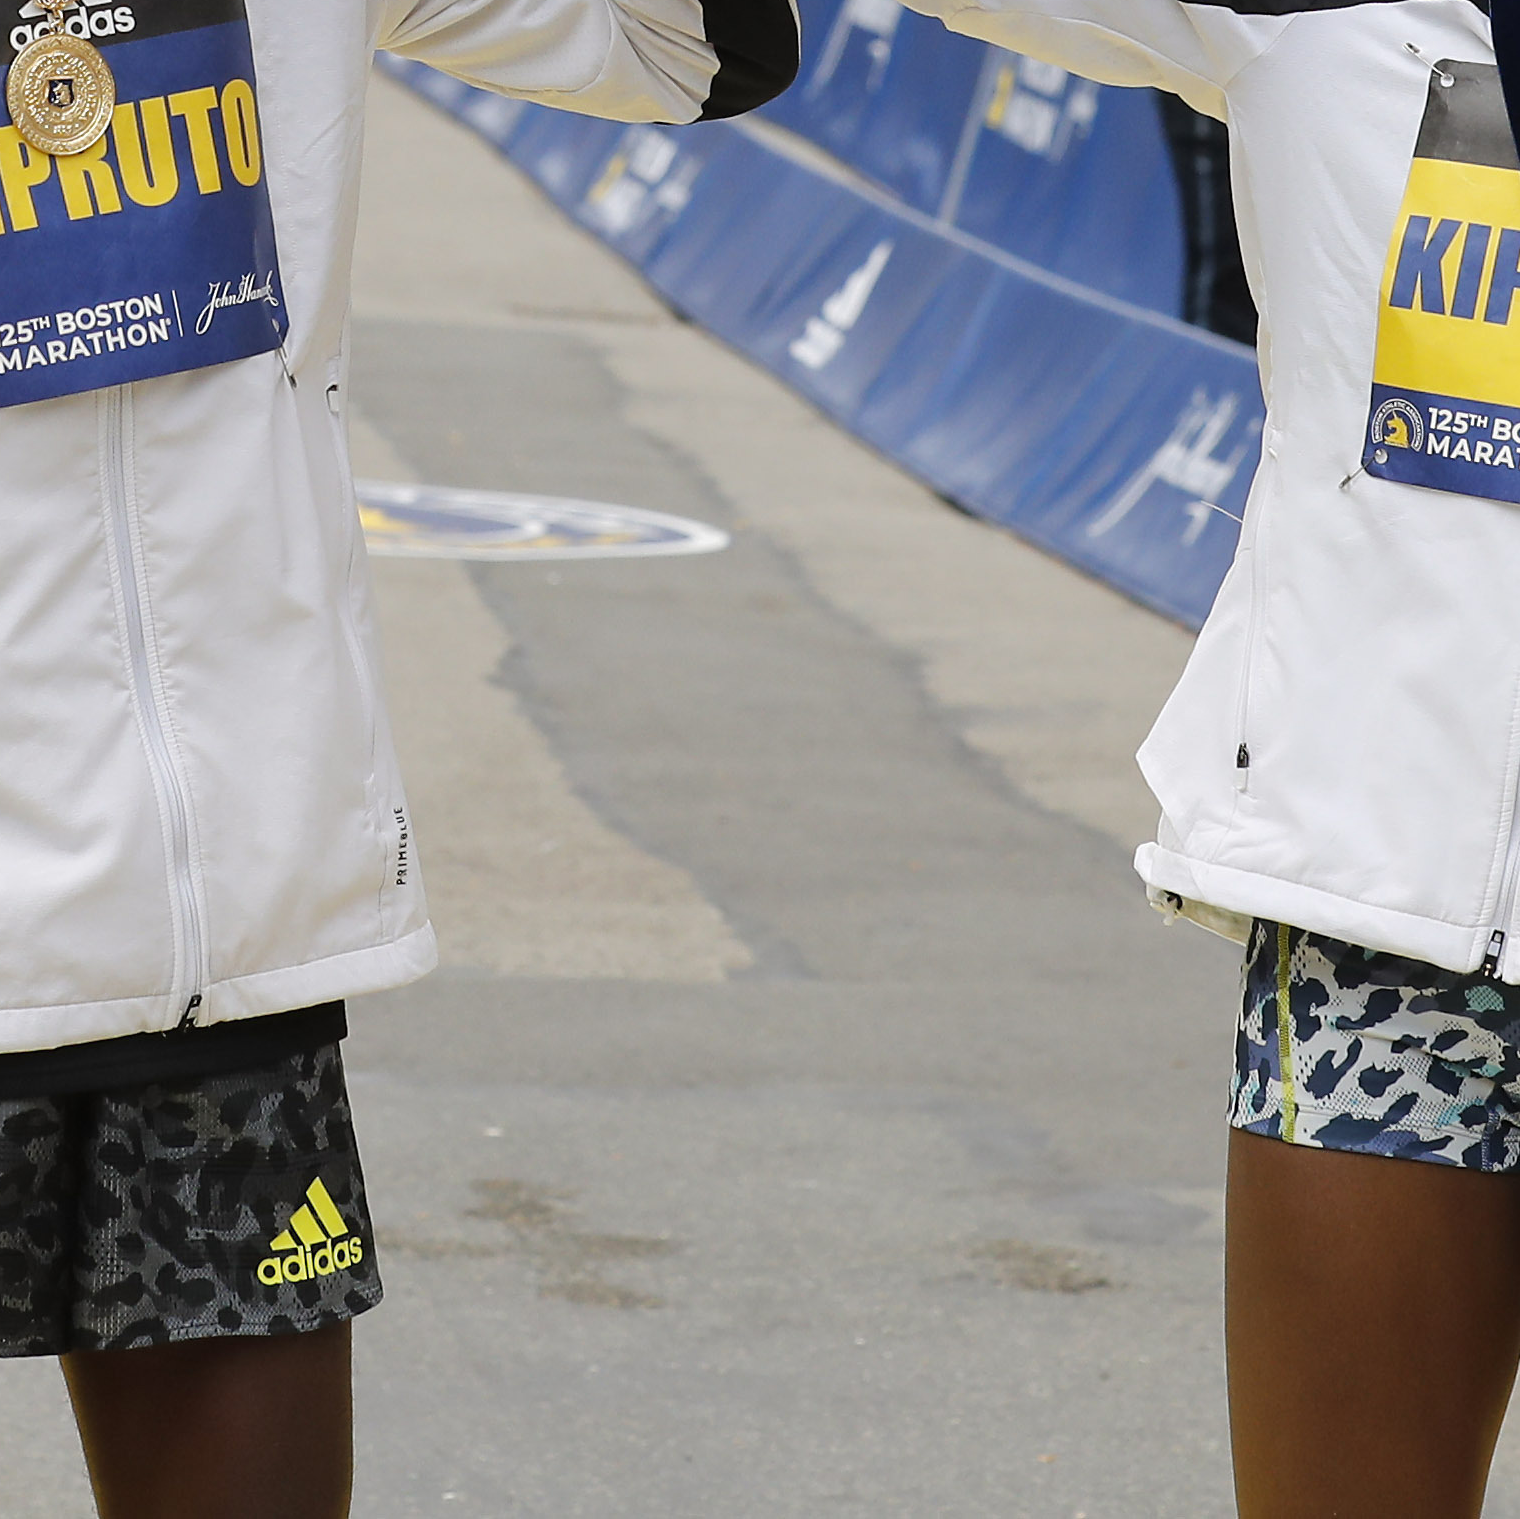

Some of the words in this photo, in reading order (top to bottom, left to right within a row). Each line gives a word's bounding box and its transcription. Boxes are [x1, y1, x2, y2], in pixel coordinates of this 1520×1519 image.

[9, 5, 135, 52] addas
[55, 292, 164, 335] BOSTON
[195, 281, 232, 335] John
[1427, 406, 1489, 435] 125TH
[393, 806, 408, 886] PRIMEBLUE
[257, 1236, 363, 1286] adidas
